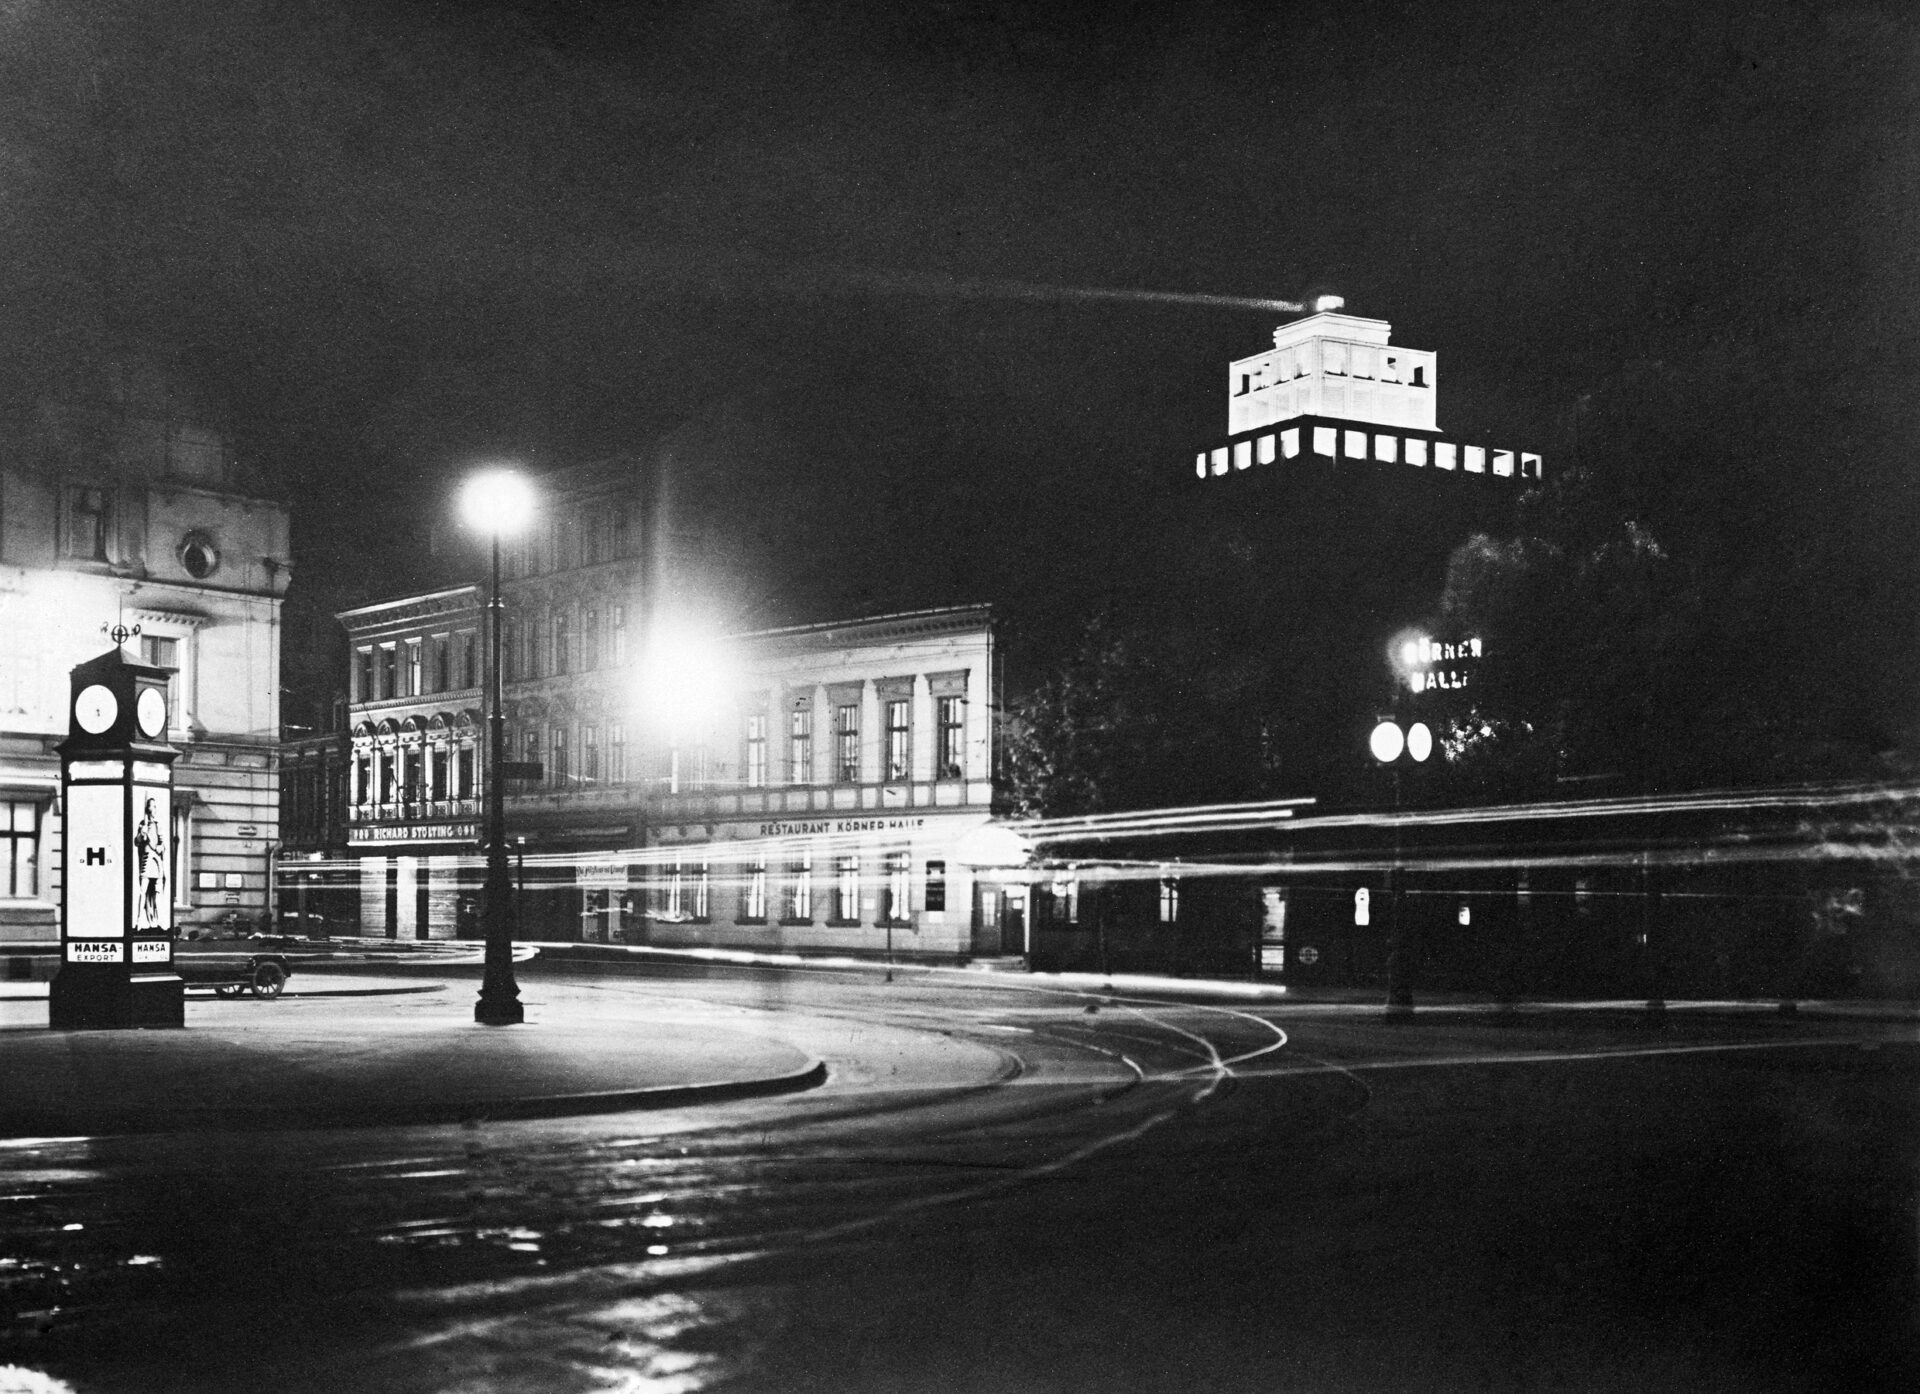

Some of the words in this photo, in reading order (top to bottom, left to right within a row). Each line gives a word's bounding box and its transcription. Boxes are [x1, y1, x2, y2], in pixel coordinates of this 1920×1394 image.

[1402, 638, 1481, 662] RNER
[373, 827, 408, 840] RICHARD
[760, 821, 830, 836] RESTAURANT
[837, 818, 884, 832] KÖRNER
[86, 847, 105, 866] H
[137, 943, 166, 952] HANSA
